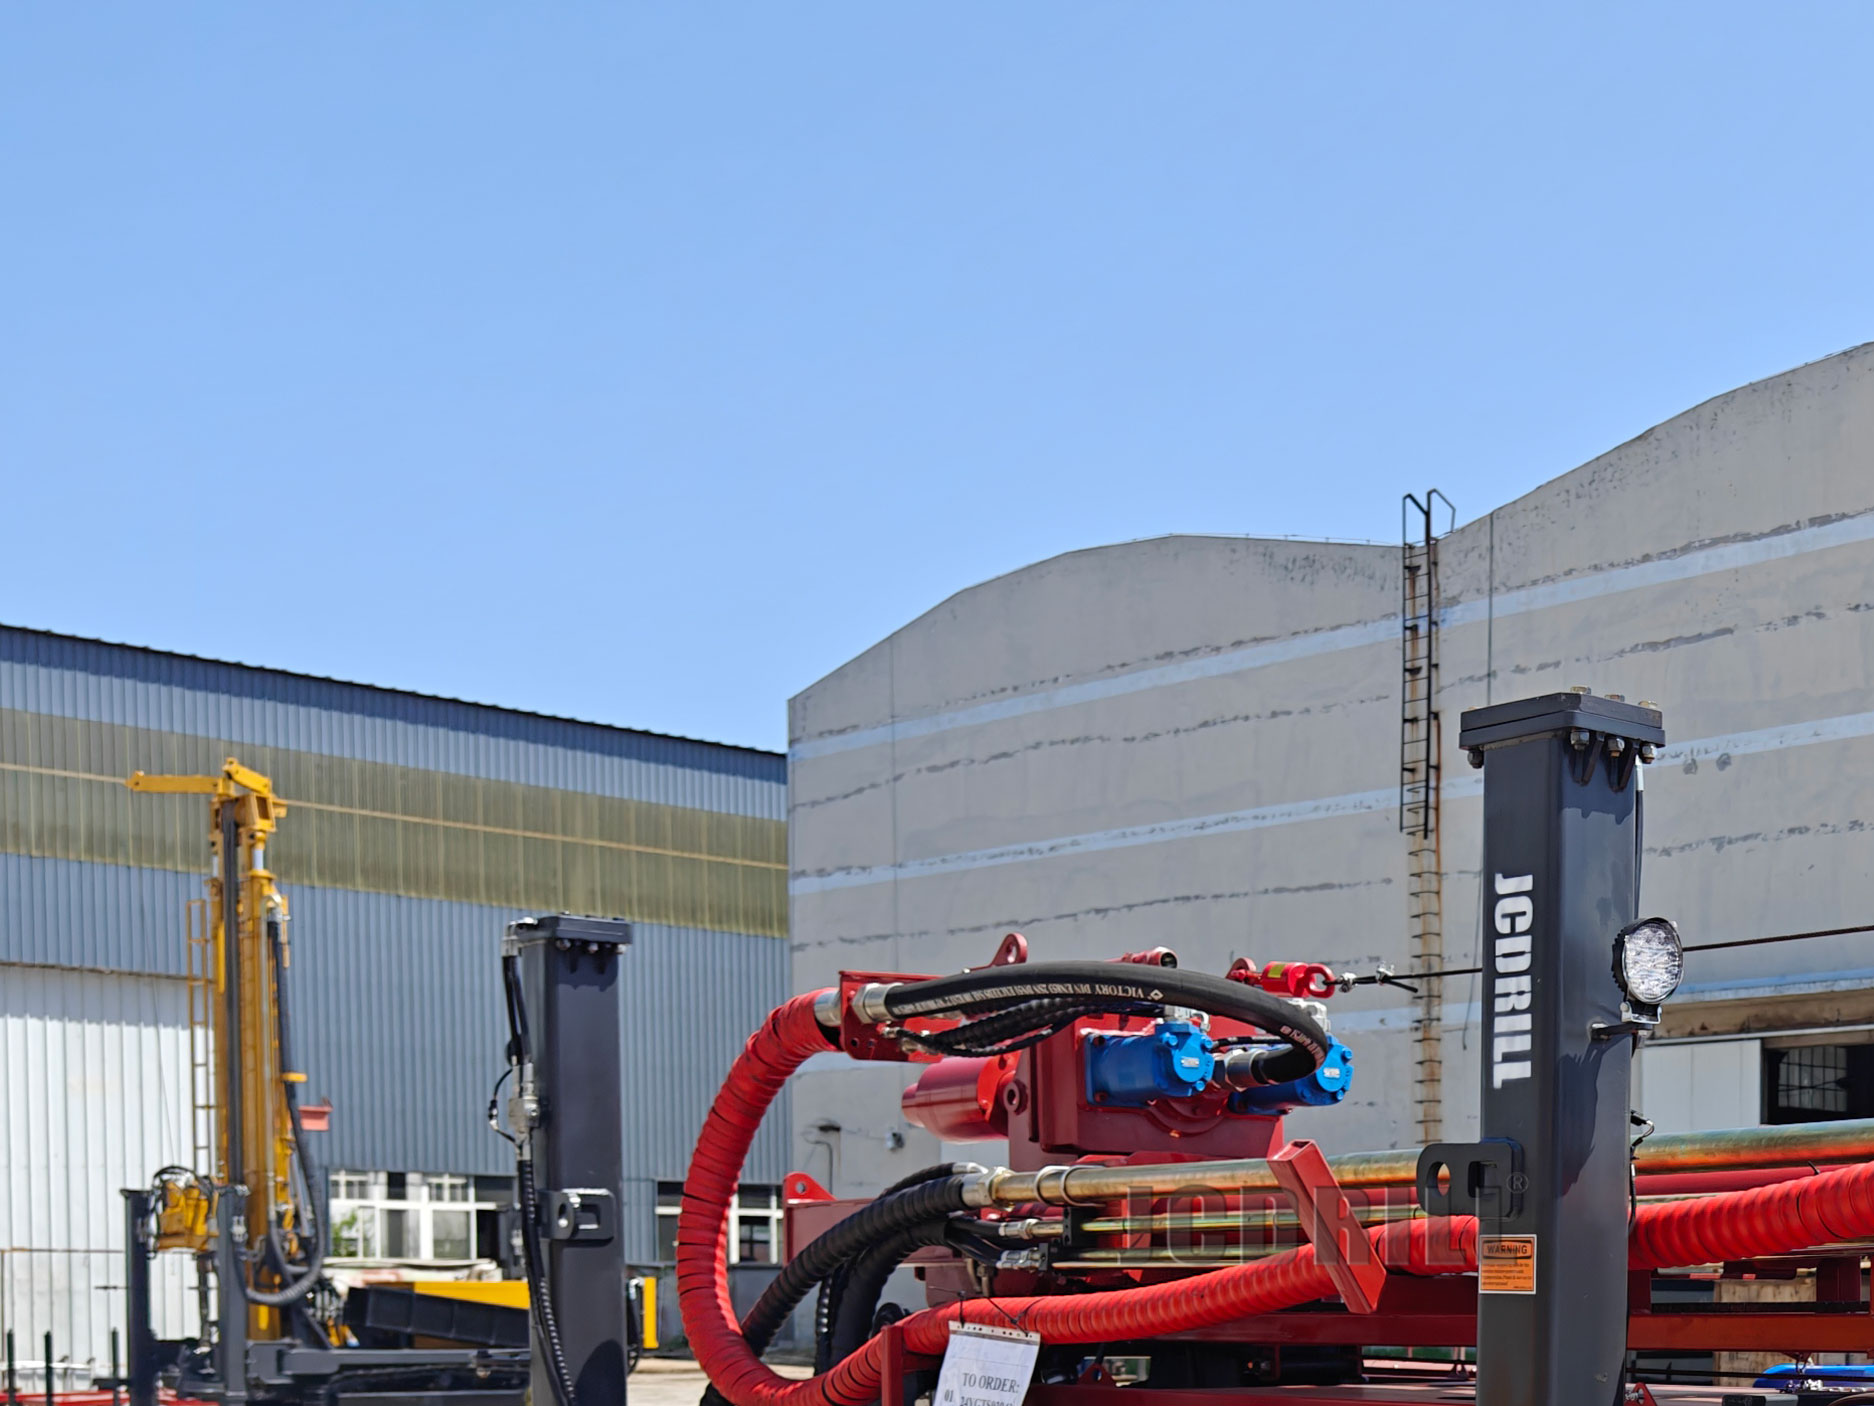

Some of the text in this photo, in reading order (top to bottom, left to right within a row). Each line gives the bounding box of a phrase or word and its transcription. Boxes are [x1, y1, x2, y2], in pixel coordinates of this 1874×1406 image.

[1493, 872, 1534, 1089] JCDRILL
[1073, 984, 1092, 994] DIN
[1094, 983, 1144, 998] VICTORY
[1487, 1244, 1528, 1255] WARNING
[962, 1372, 1020, 1394] TO ORDER:
[944, 1390, 954, 1403] 01
